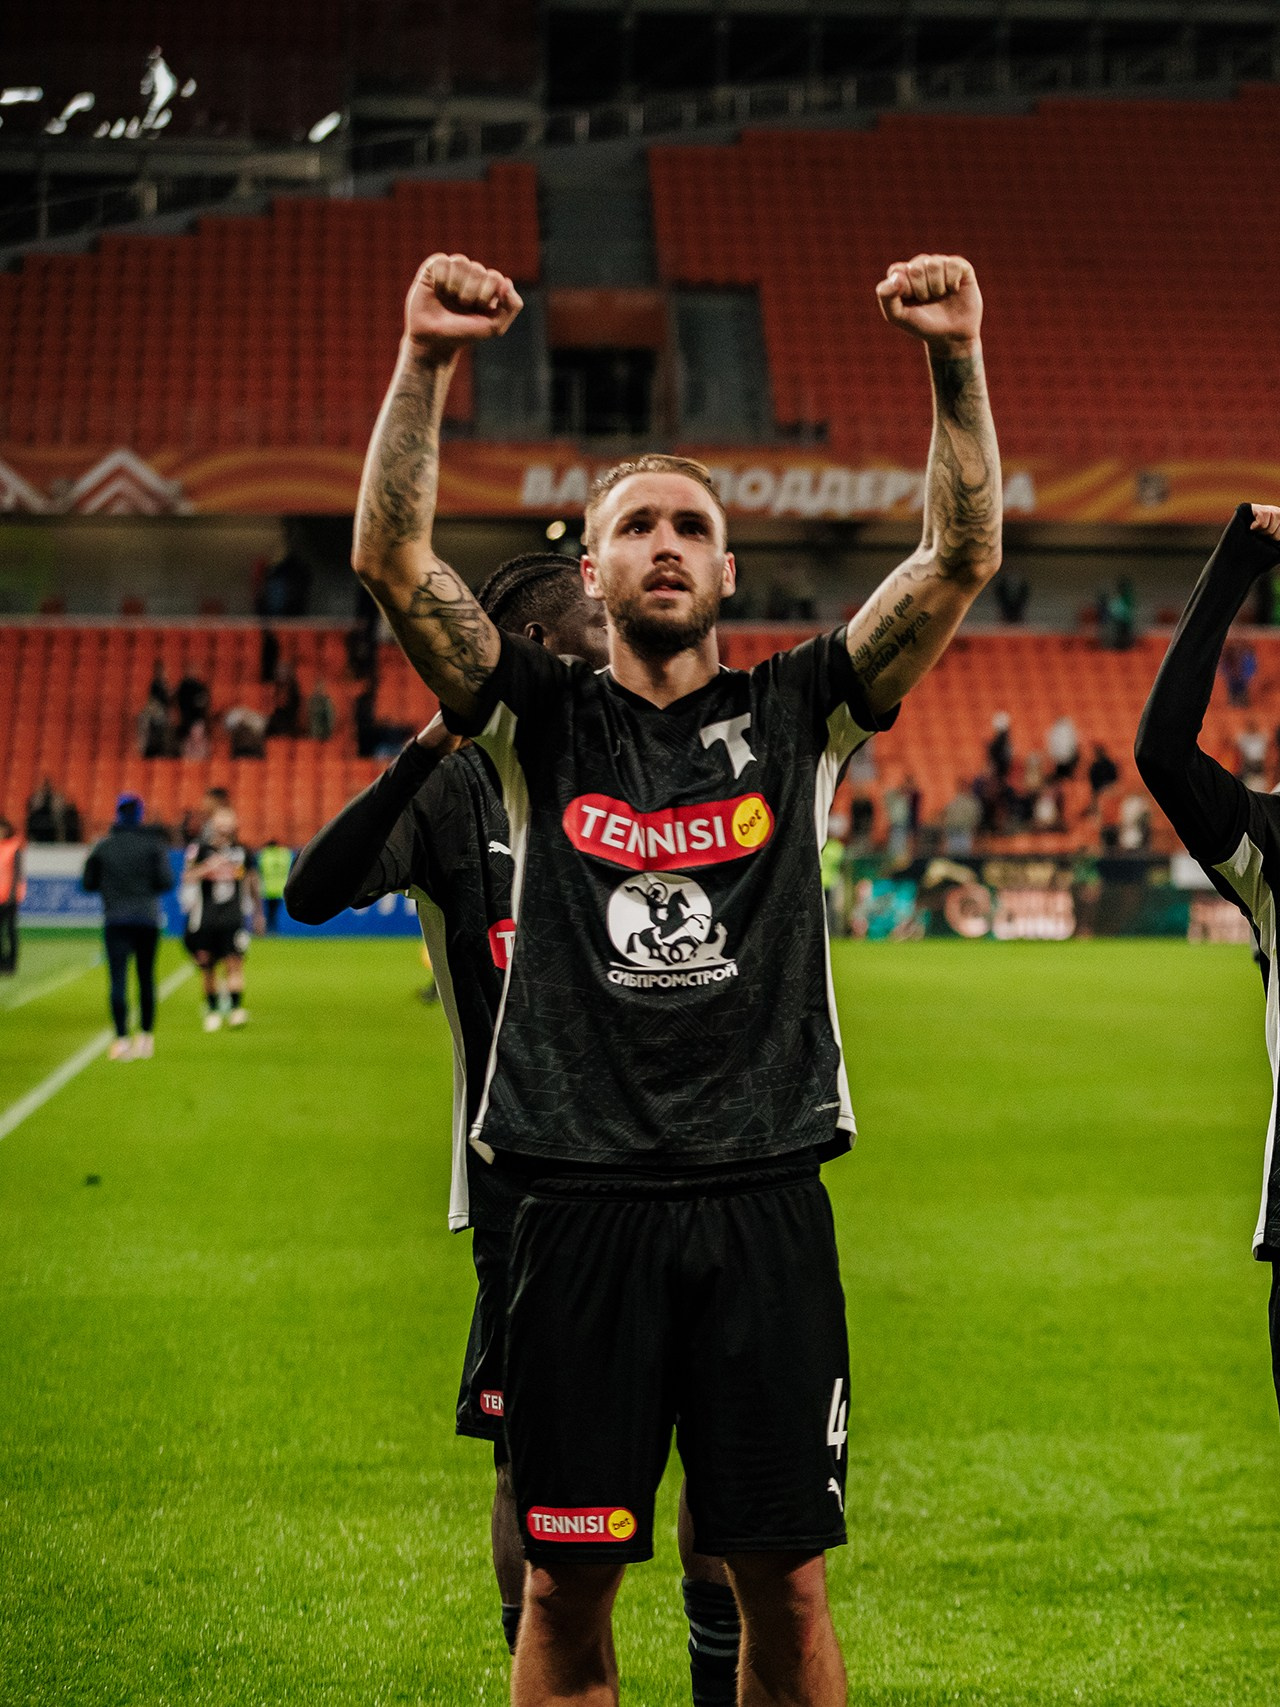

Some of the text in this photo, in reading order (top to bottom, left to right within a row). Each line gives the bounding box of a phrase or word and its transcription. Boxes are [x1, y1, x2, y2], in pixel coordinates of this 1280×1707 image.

[580, 804, 763, 858] TENNISI bet
[607, 962, 739, 988] СИБПРОМСТРОЙ
[827, 1378, 847, 1460] 4
[532, 1512, 631, 1533] TENNISI bet
